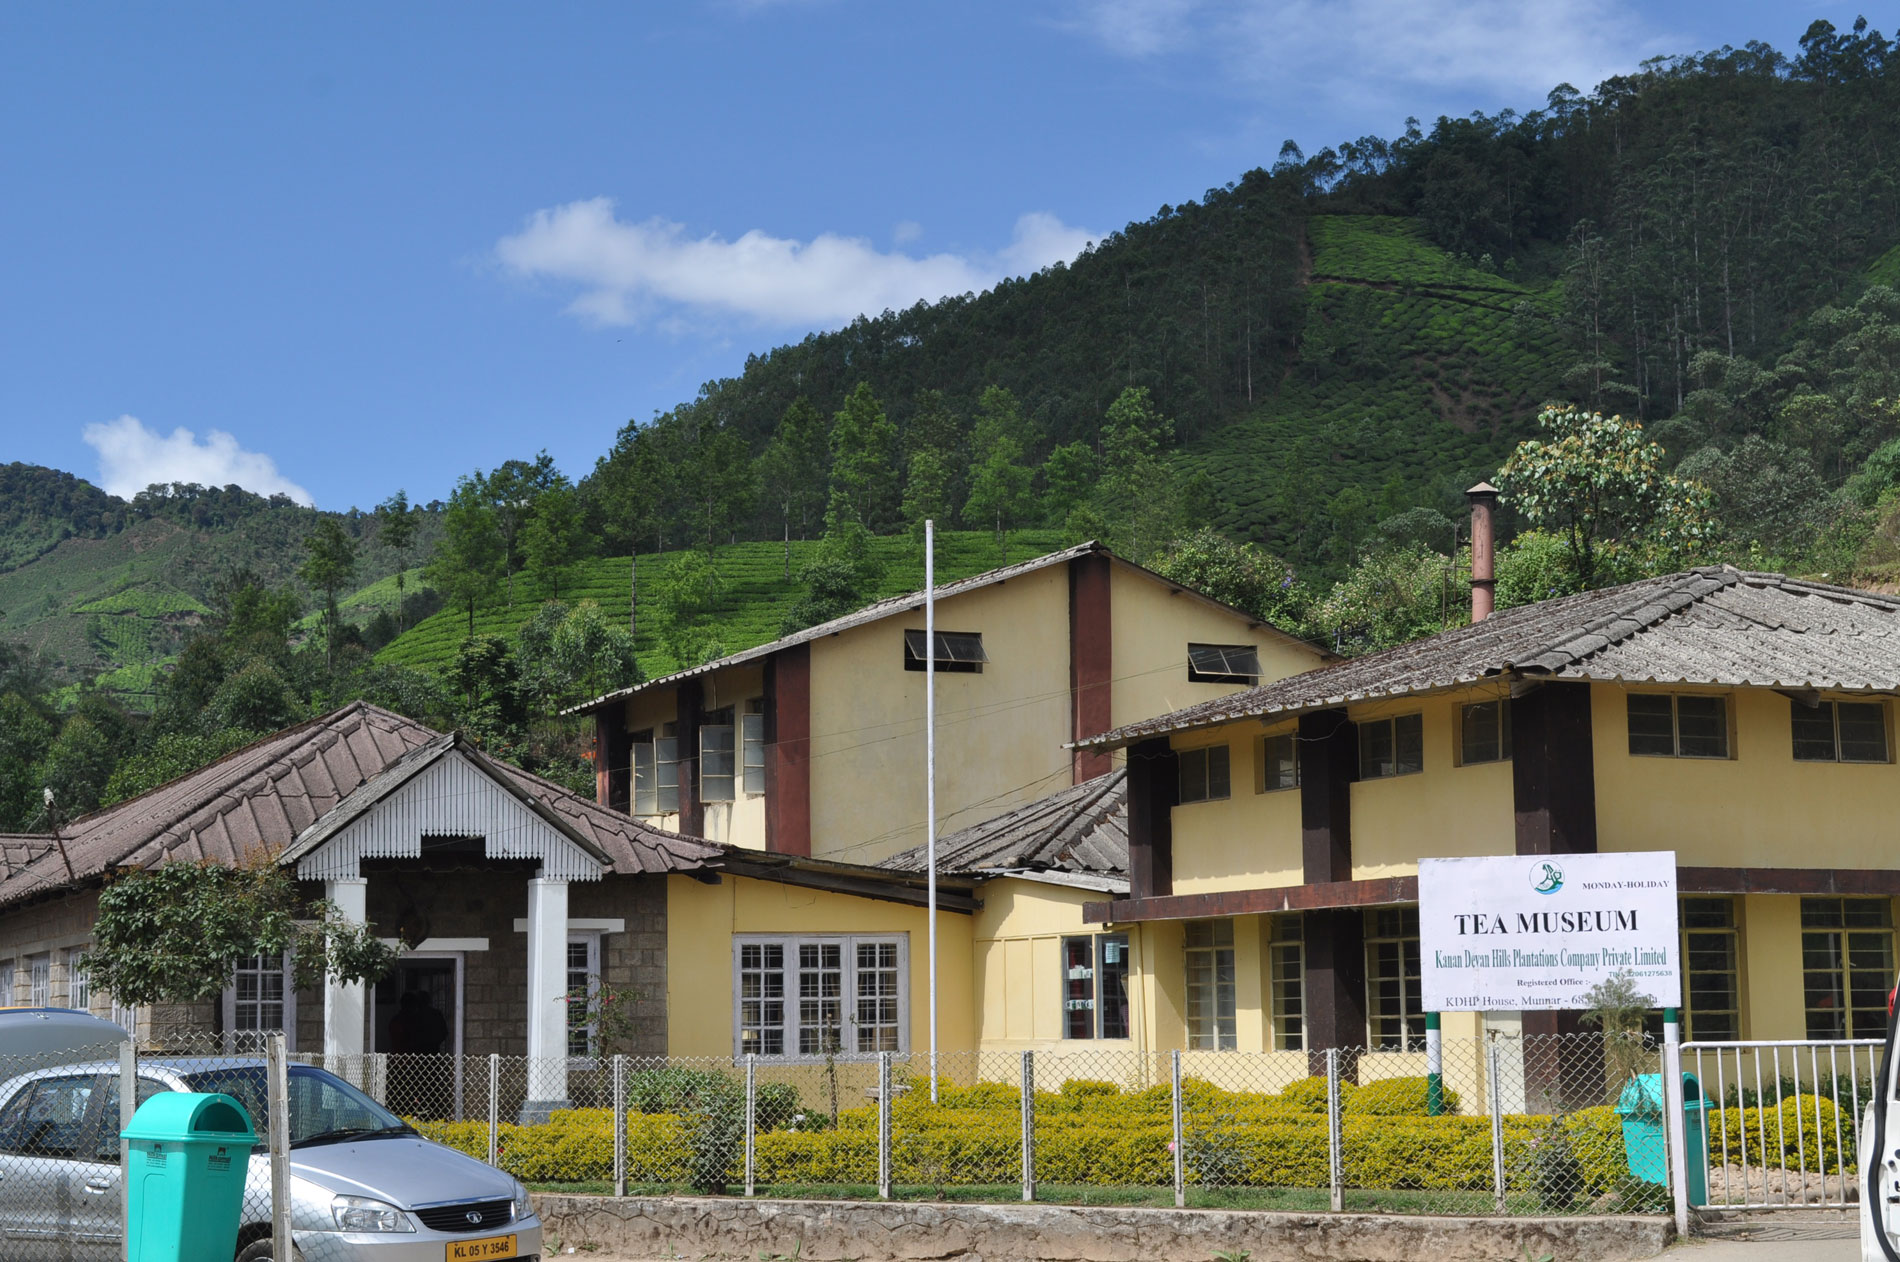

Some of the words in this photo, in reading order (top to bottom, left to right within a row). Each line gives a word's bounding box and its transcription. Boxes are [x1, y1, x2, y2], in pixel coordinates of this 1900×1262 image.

[1582, 881, 1670, 890] MONDAY-HOLIDAY
[1454, 913, 1508, 935] TEA
[1517, 910, 1639, 933] MUSEUM
[1435, 950, 1462, 968] Kanan
[1464, 949, 1490, 968] Devan
[1492, 949, 1511, 968] Hills
[1513, 948, 1558, 967] Plantations
[1560, 947, 1601, 971] Company
[1602, 947, 1632, 966] Private
[1634, 946, 1667, 965] Limited
[1517, 979, 1558, 988] Registered
[1559, 978, 1583, 986] Office
[1446, 996, 1480, 1007] KDHP
[1482, 996, 1518, 1006] House,
[1521, 996, 1561, 1006] Munnar
[454, 1247, 466, 1258] KL
[469, 1245, 480, 1256] 05
[482, 1244, 488, 1254] Y
[490, 1241, 509, 1254] 3546
